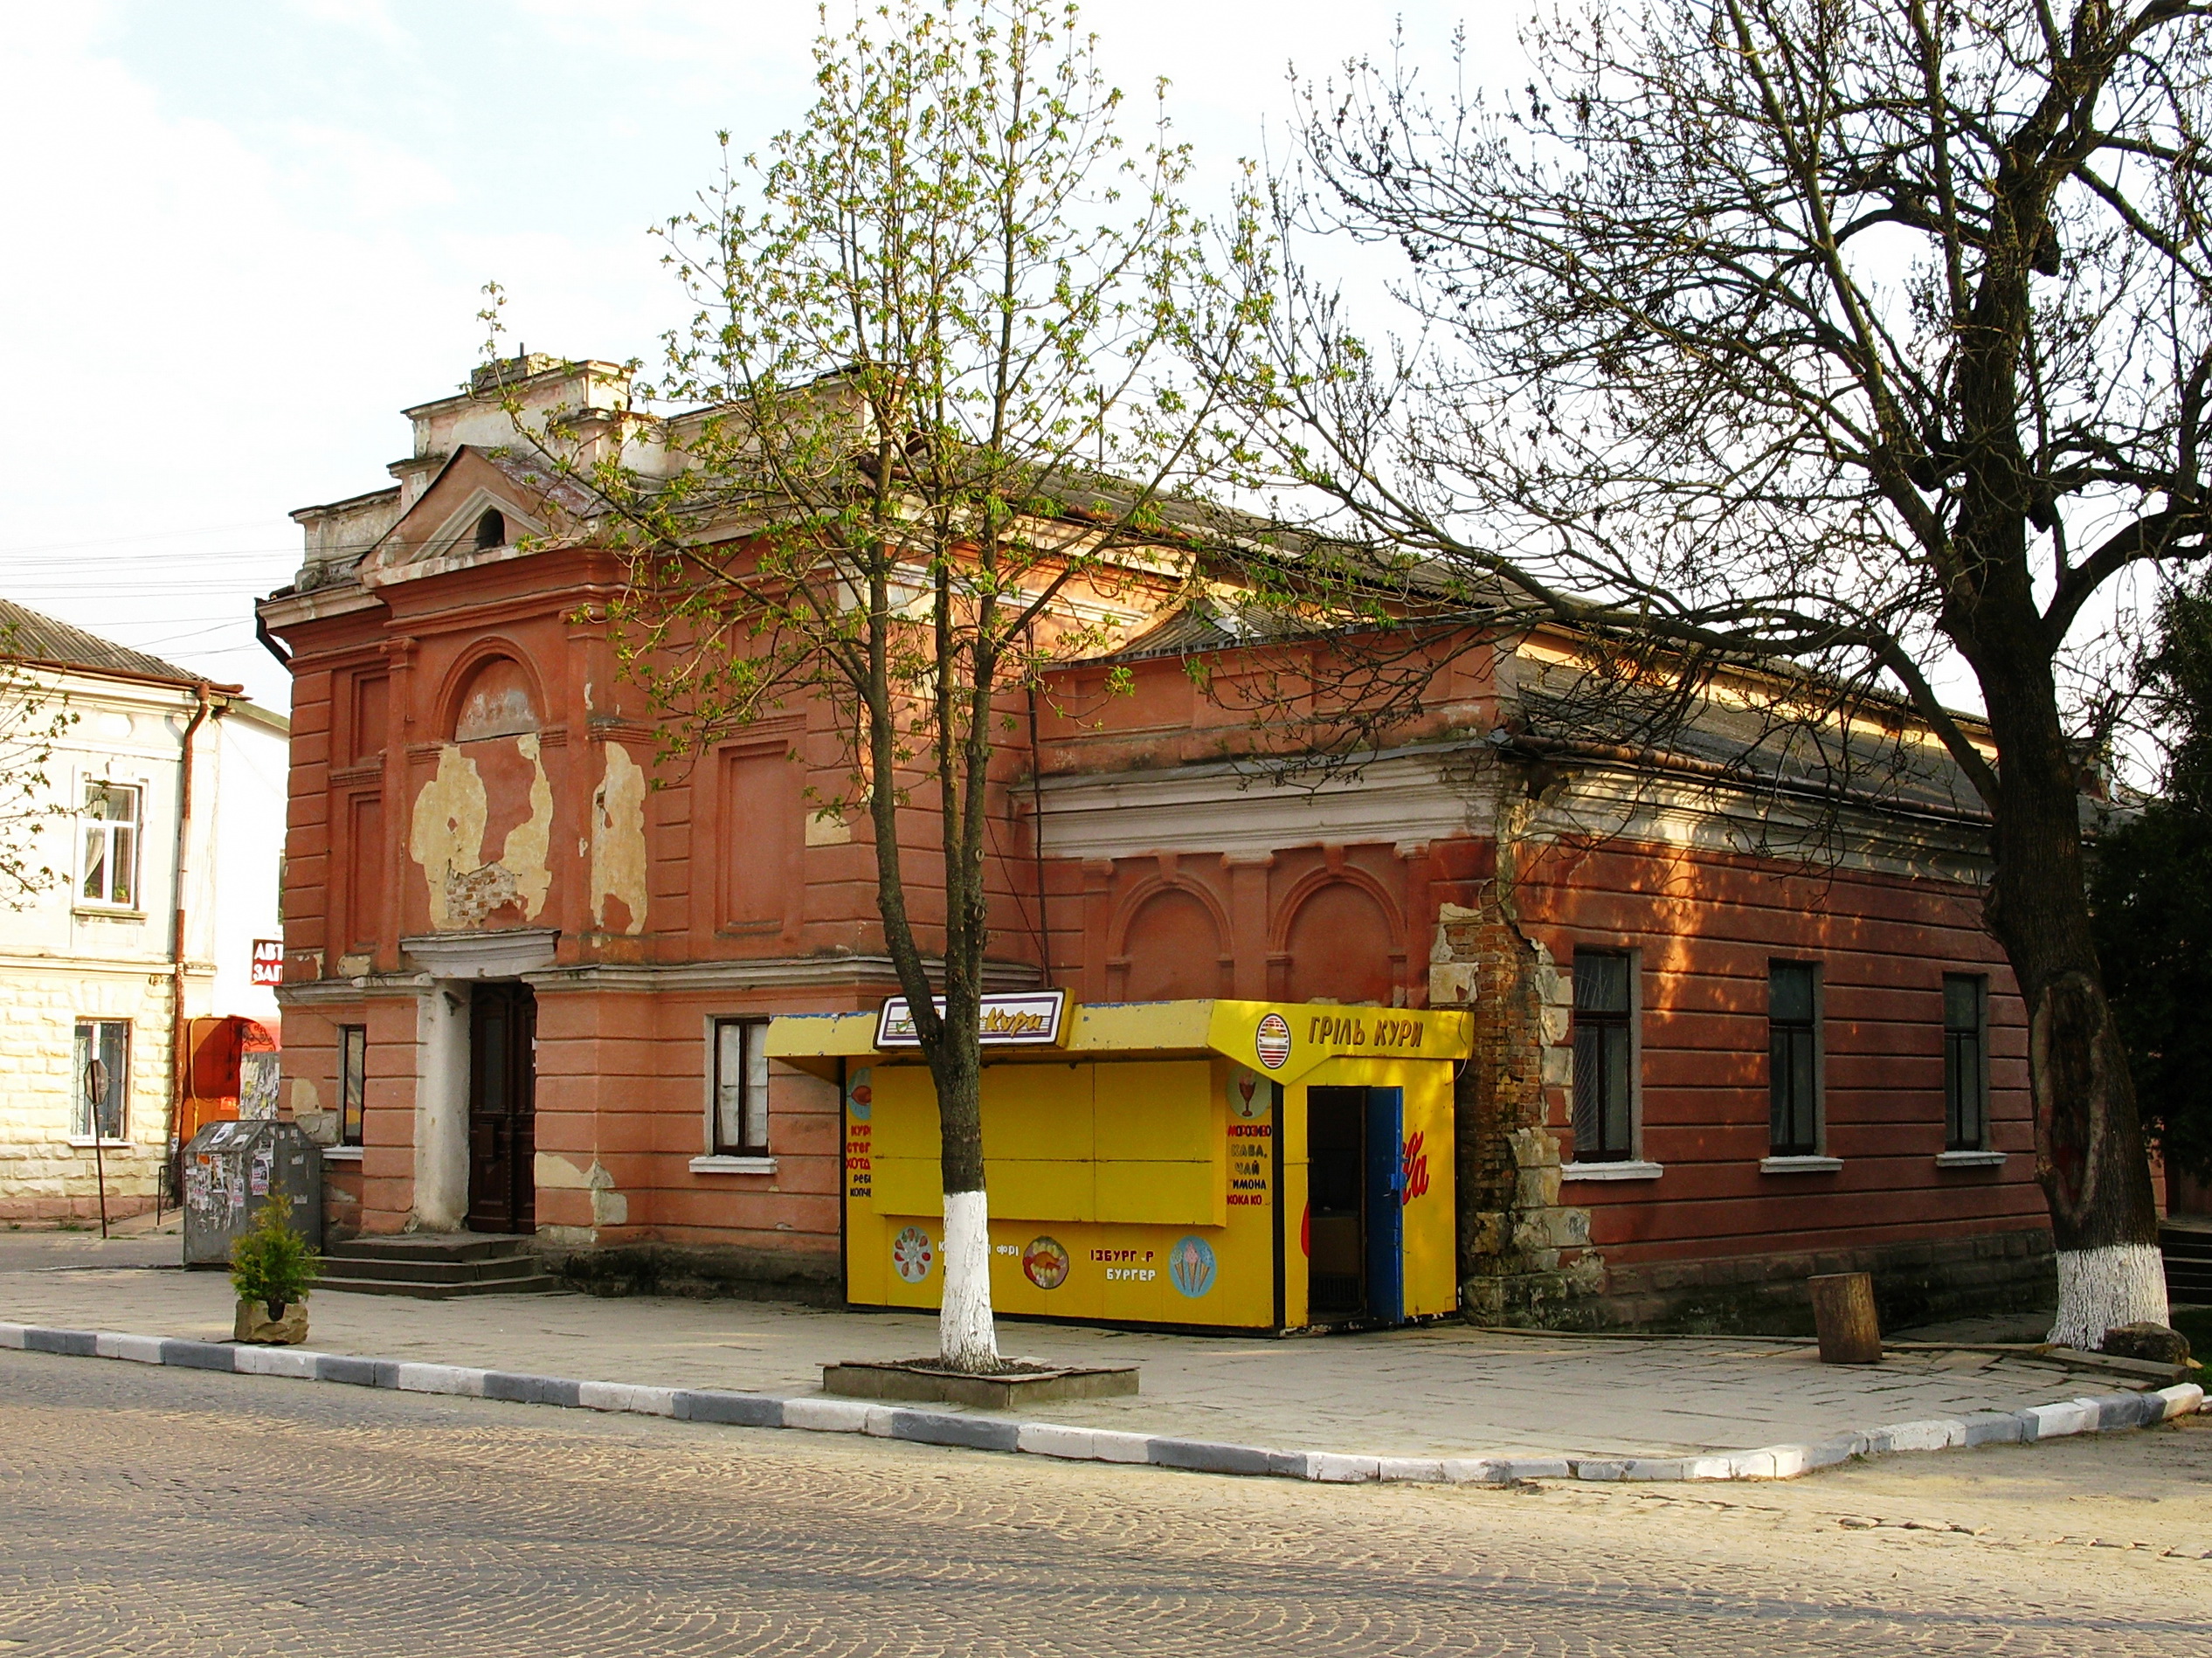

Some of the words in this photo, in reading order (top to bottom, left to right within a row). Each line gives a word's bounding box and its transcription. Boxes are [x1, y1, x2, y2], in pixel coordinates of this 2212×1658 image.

[1309, 1017, 1365, 1046] ГРІЛЬ
[1374, 1019, 1423, 1047] КУРИ
[1228, 1125, 1271, 1136] МОРОЗИВО
[1234, 1160, 1260, 1175] ЧАЙ
[1106, 1268, 1156, 1281] БУРГЕР
